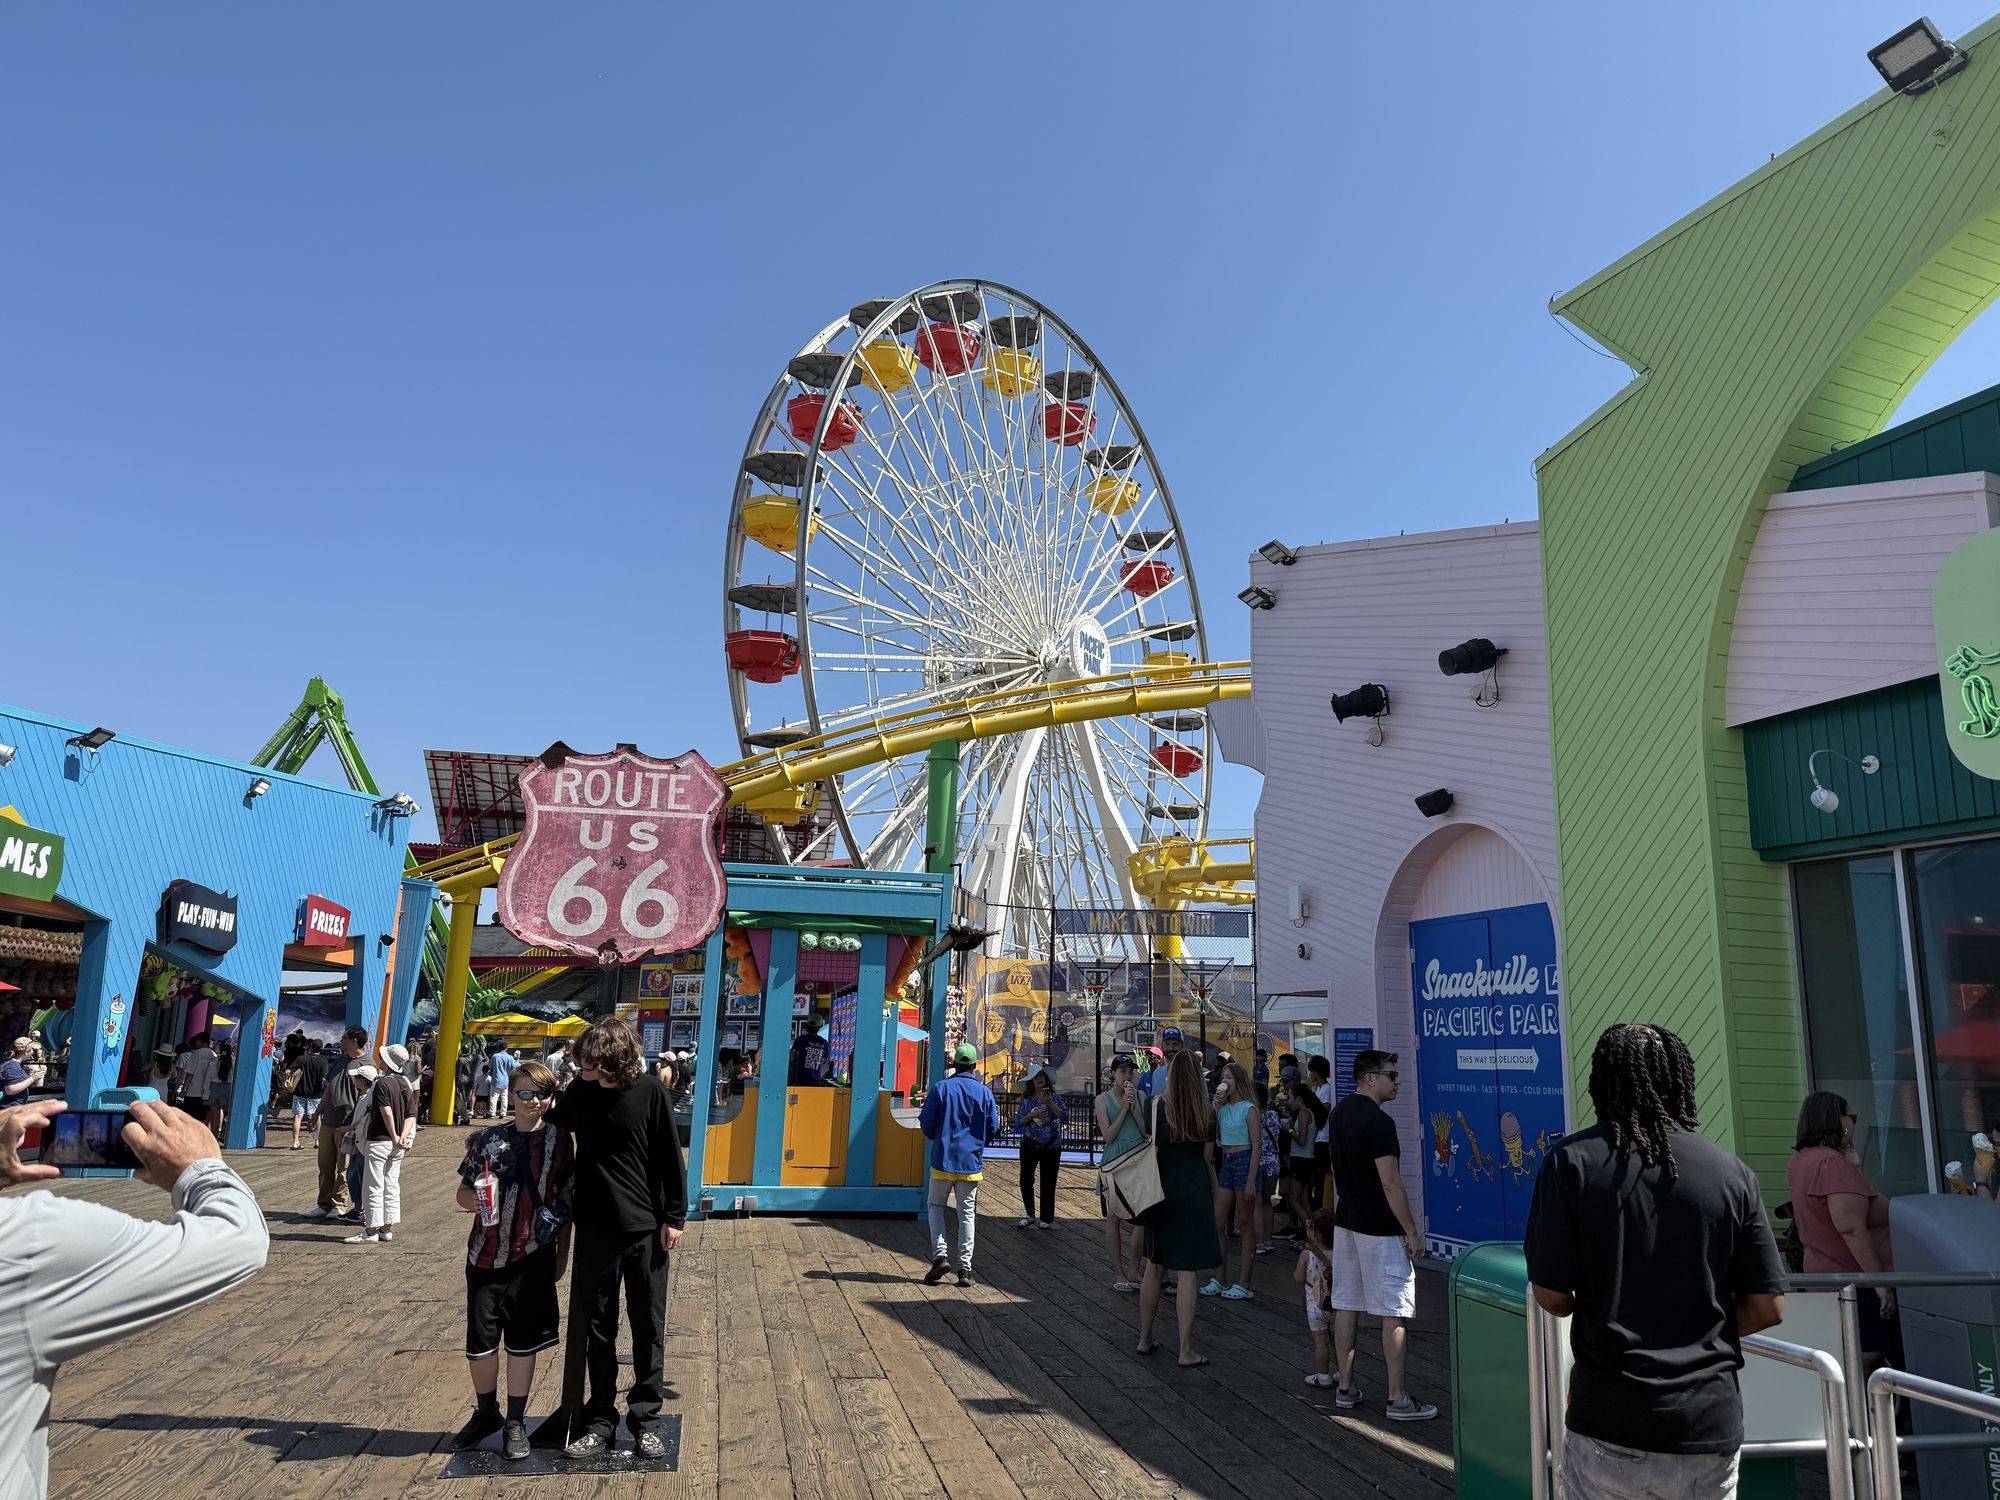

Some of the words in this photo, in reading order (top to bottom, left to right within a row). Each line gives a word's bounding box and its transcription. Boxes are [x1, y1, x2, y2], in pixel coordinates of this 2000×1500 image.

[1080, 631, 1104, 659] PACIFIC
[1084, 652, 1101, 676] PARK
[553, 767, 692, 810] ROUTE
[547, 855, 679, 939] 66
[310, 908, 345, 938] PRIZES
[1090, 911, 1127, 932] MAKE
[1161, 913, 1180, 934] TO
[1183, 914, 1215, 935] WIN!
[1422, 954, 1540, 1001] Snackville
[1423, 1004, 1505, 1037] PACIFIC
[1509, 1003, 1559, 1035] PAR
[804, 1060, 821, 1070] EAT
[806, 1046, 824, 1057] RIDE
[1460, 1055, 1473, 1064] THIS
[1474, 1055, 1487, 1064] WAY
[1489, 1056, 1496, 1064] TO
[1499, 1055, 1534, 1064] DELICIOUS
[1437, 1083, 1455, 1092] SWEET
[1456, 1084, 1477, 1093] TREATS
[1501, 1085, 1518, 1094] BITES
[1523, 1086, 1541, 1096] COLD
[1977, 1362, 1996, 1397] NLY
